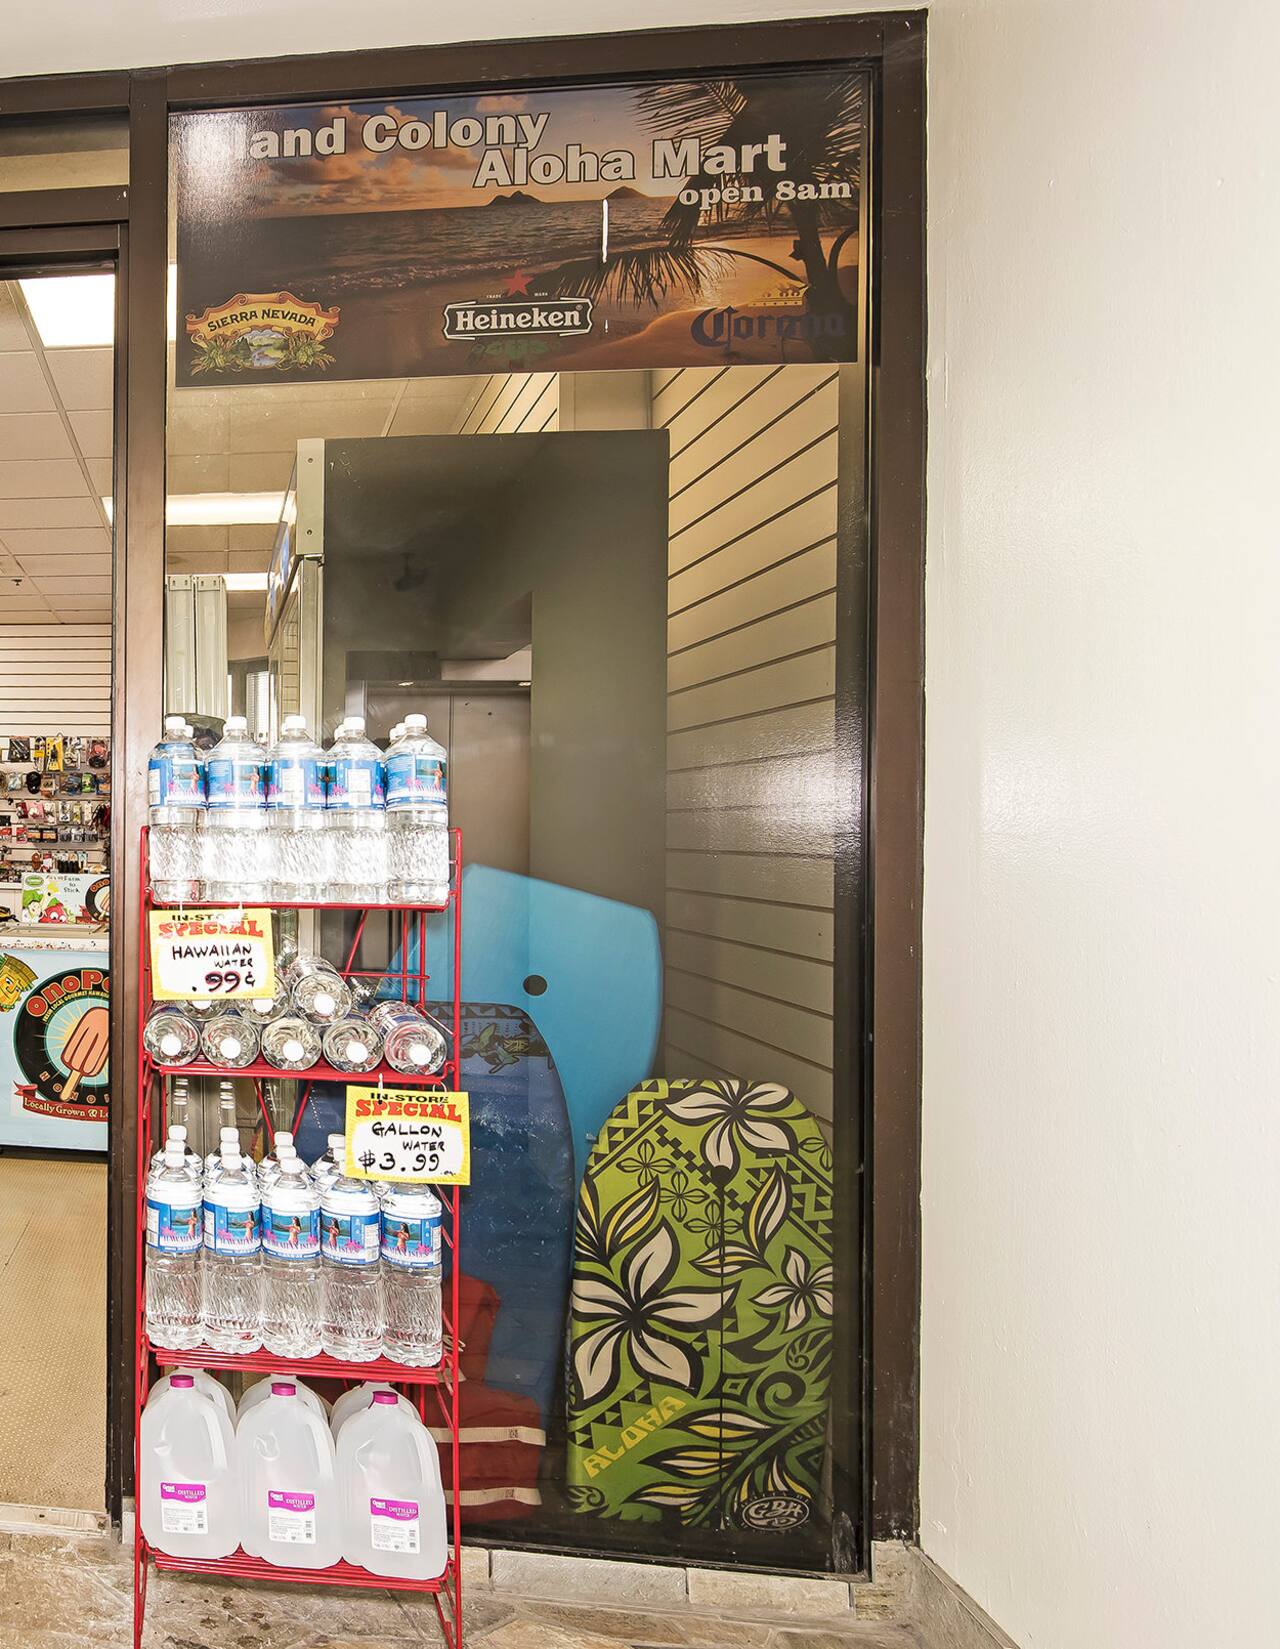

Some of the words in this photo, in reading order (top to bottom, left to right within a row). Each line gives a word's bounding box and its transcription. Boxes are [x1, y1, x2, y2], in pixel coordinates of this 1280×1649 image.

[361, 110, 551, 153] Colony
[472, 143, 637, 188] Aloha
[651, 133, 788, 179] Mart
[678, 185, 764, 211] open
[775, 180, 852, 201] 8am
[207, 309, 258, 332] SIERRA
[261, 307, 316, 327] NEVADA
[455, 307, 582, 331] Heineken
[172, 912, 249, 922] IN-STOE
[159, 920, 264, 939] SPECIAL
[172, 943, 252, 960] HAWAIIAN
[214, 957, 254, 968] WATER
[24, 1098, 55, 1113] Locally
[55, 1105, 86, 1117] Grown
[370, 1092, 449, 1104] IN-STORE
[356, 1099, 462, 1123] SPECIAL
[372, 1121, 442, 1138] GALLON
[402, 1141, 445, 1152] WATER
[358, 1149, 440, 1174] $3.99
[583, 1396, 686, 1479] ALOHA
